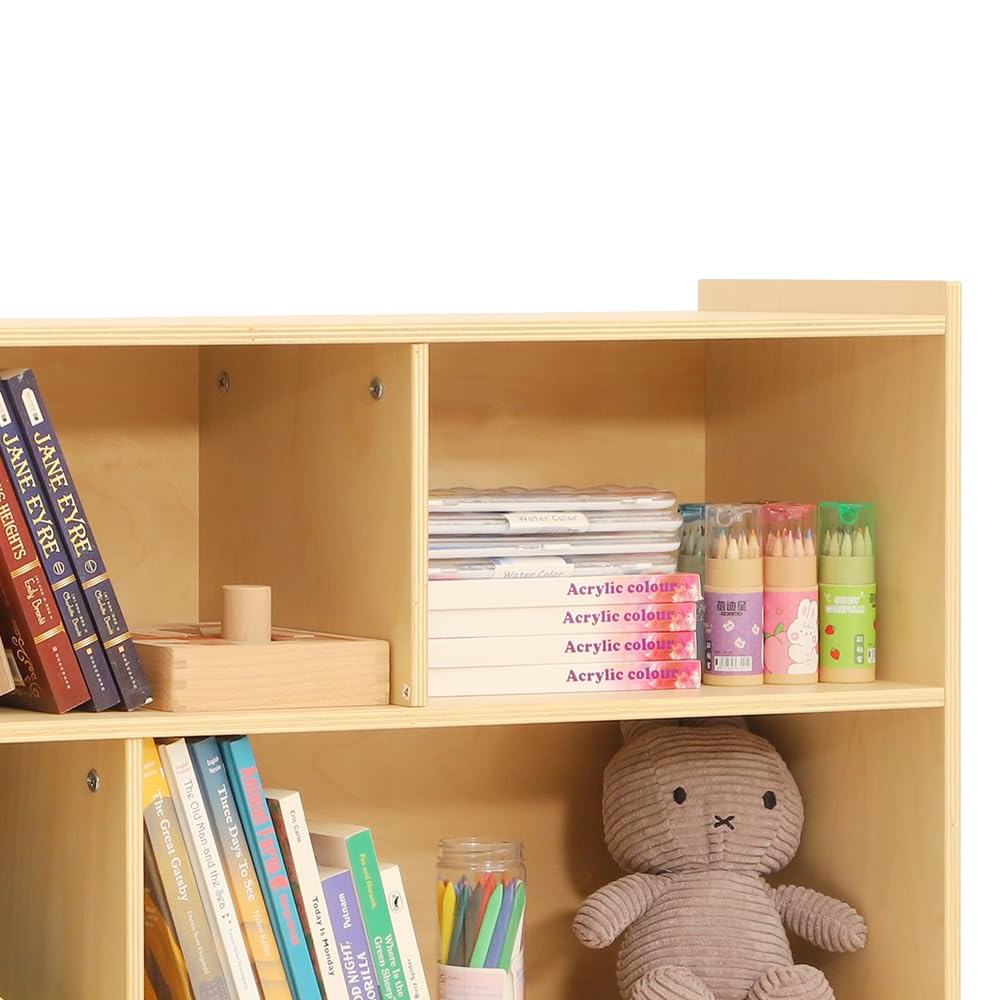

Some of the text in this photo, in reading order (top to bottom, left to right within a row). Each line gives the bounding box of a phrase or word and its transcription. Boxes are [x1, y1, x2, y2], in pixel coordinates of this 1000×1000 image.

[2, 432, 36, 494] JANE
[26, 494, 60, 559] EYRE
[34, 431, 92, 557] JANE EYRE
[567, 580, 678, 597] Acrylic colour
[563, 609, 674, 625] Acrylic colour
[564, 639, 674, 654] Acrylic colour
[566, 667, 678, 684] Acrylic colour
[152, 791, 189, 902] The Great Gatsby
[183, 779, 226, 910] The Old Man and the Sea
[217, 784, 256, 901] Three Days To See
[338, 893, 352, 928] Putnam
[312, 896, 323, 925] Today
[322, 938, 335, 976] Monday
[374, 937, 386, 966] Green
[340, 940, 357, 984] NIGHT,
[383, 934, 405, 998] Where Is the
[407, 958, 416, 981] Spider
